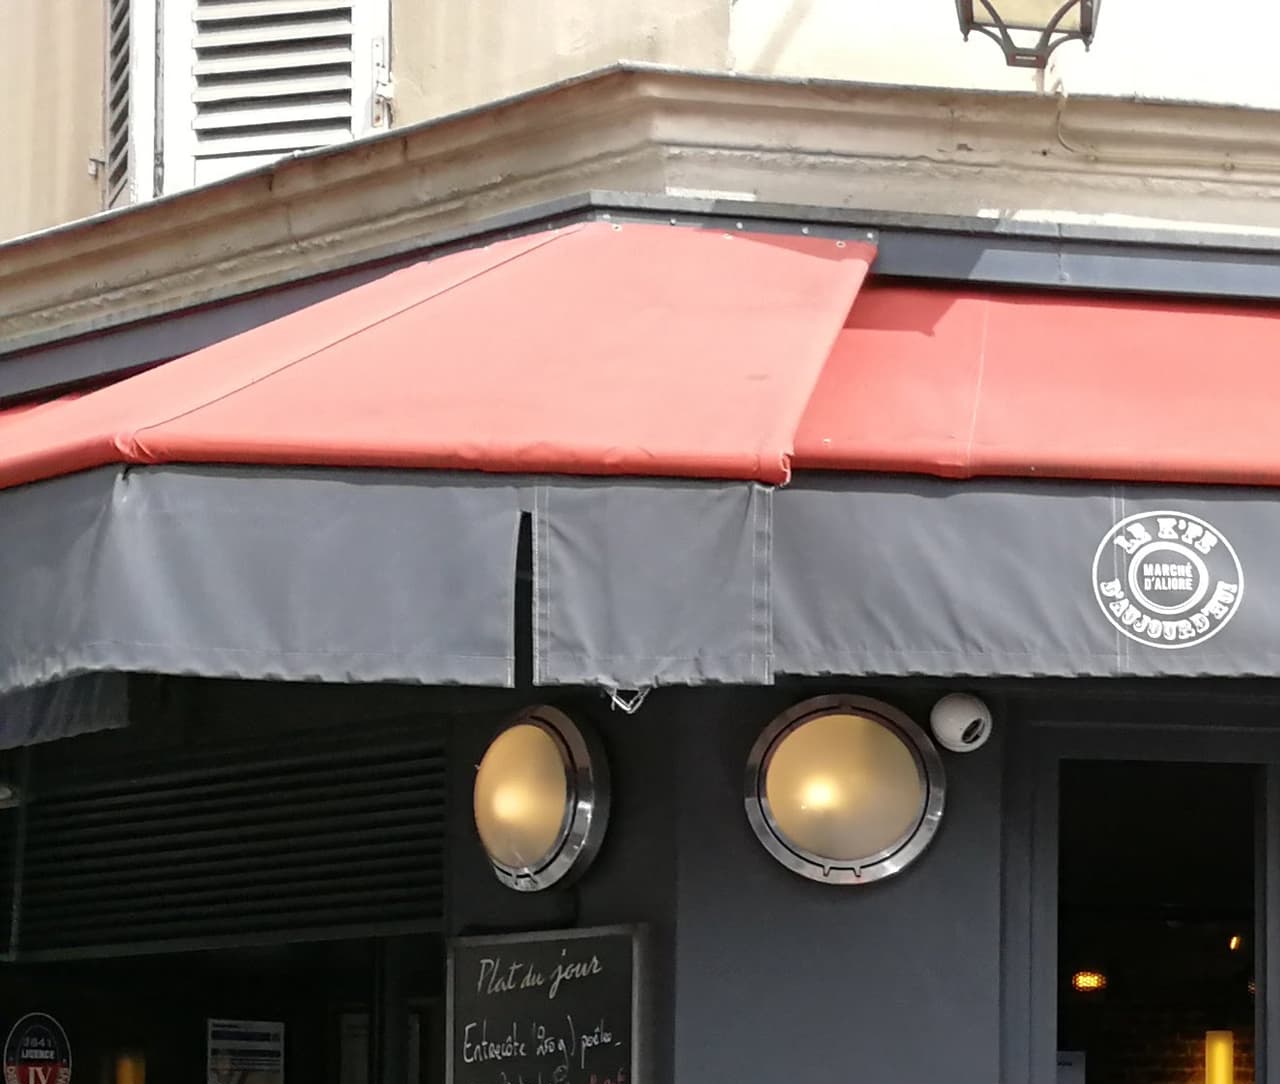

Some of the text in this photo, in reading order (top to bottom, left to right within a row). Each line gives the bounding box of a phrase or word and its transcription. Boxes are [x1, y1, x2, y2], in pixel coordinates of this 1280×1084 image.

[1113, 522, 1152, 554] LE
[1143, 561, 1193, 577] MARCHÉ
[1144, 578, 1193, 591] D'ALIGRE
[1100, 578, 1238, 640] D'AUJOURD'HUI
[477, 948, 603, 1000] Plat du jour
